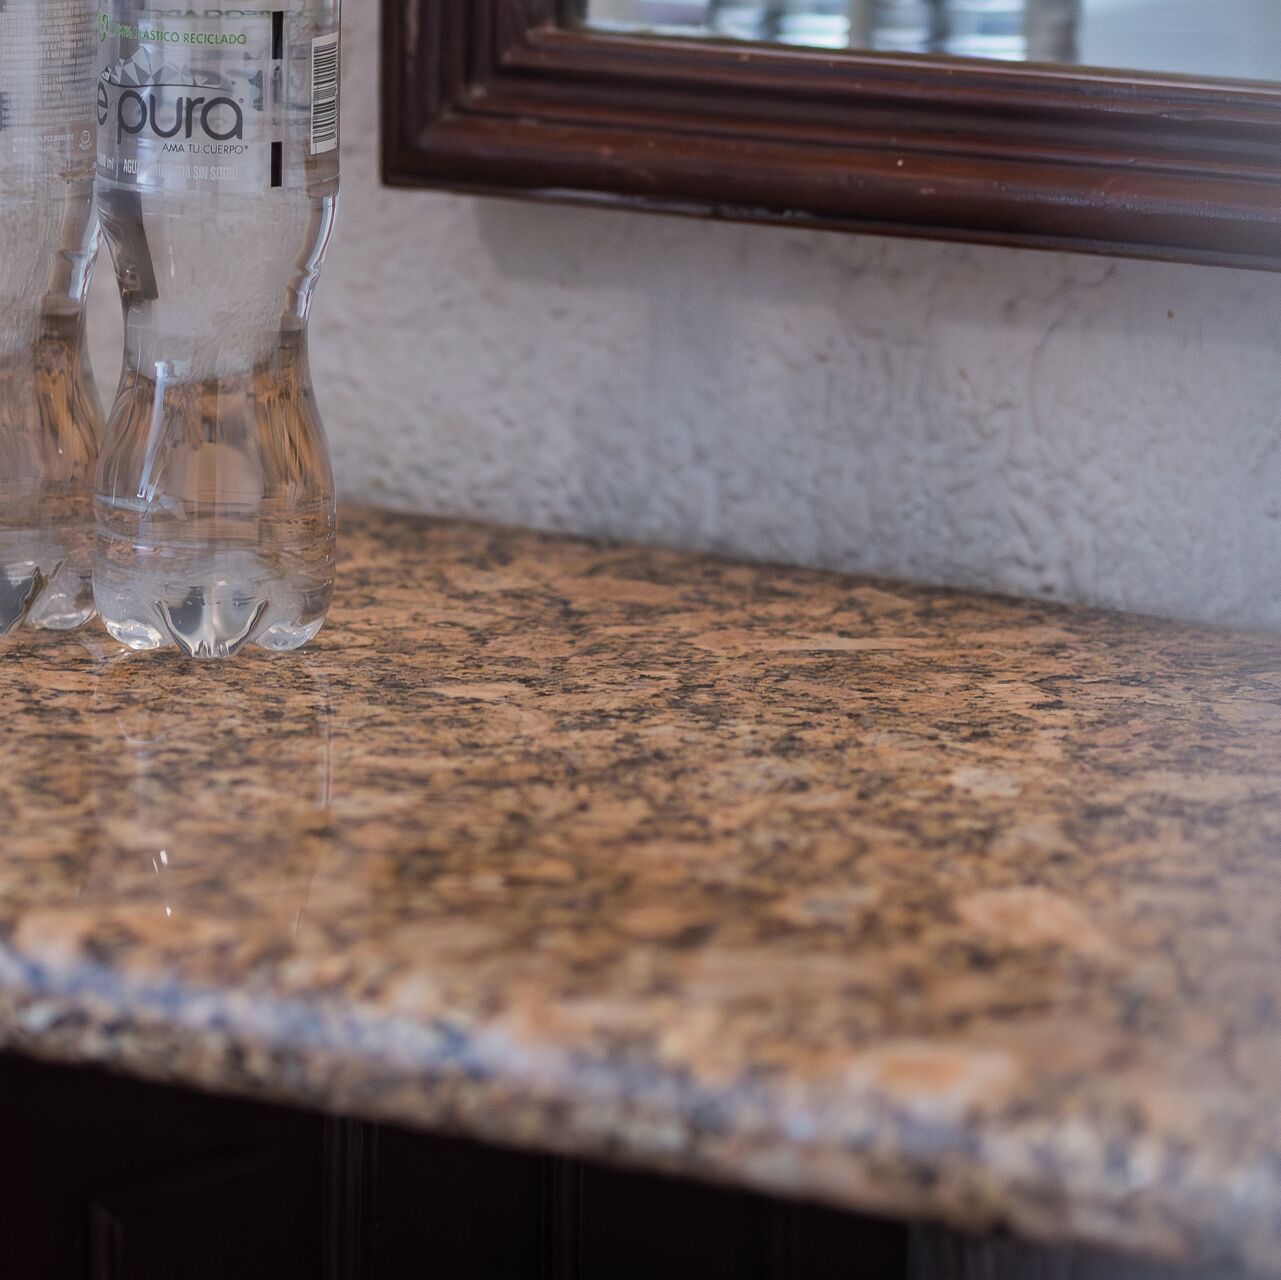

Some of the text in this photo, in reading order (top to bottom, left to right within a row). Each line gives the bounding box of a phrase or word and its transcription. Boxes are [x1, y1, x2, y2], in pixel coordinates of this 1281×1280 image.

[183, 32, 247, 45] RECICLADO
[117, 90, 243, 145] pura
[162, 143, 244, 155] AMA TU CUERPO
[192, 165, 208, 180] SIN
